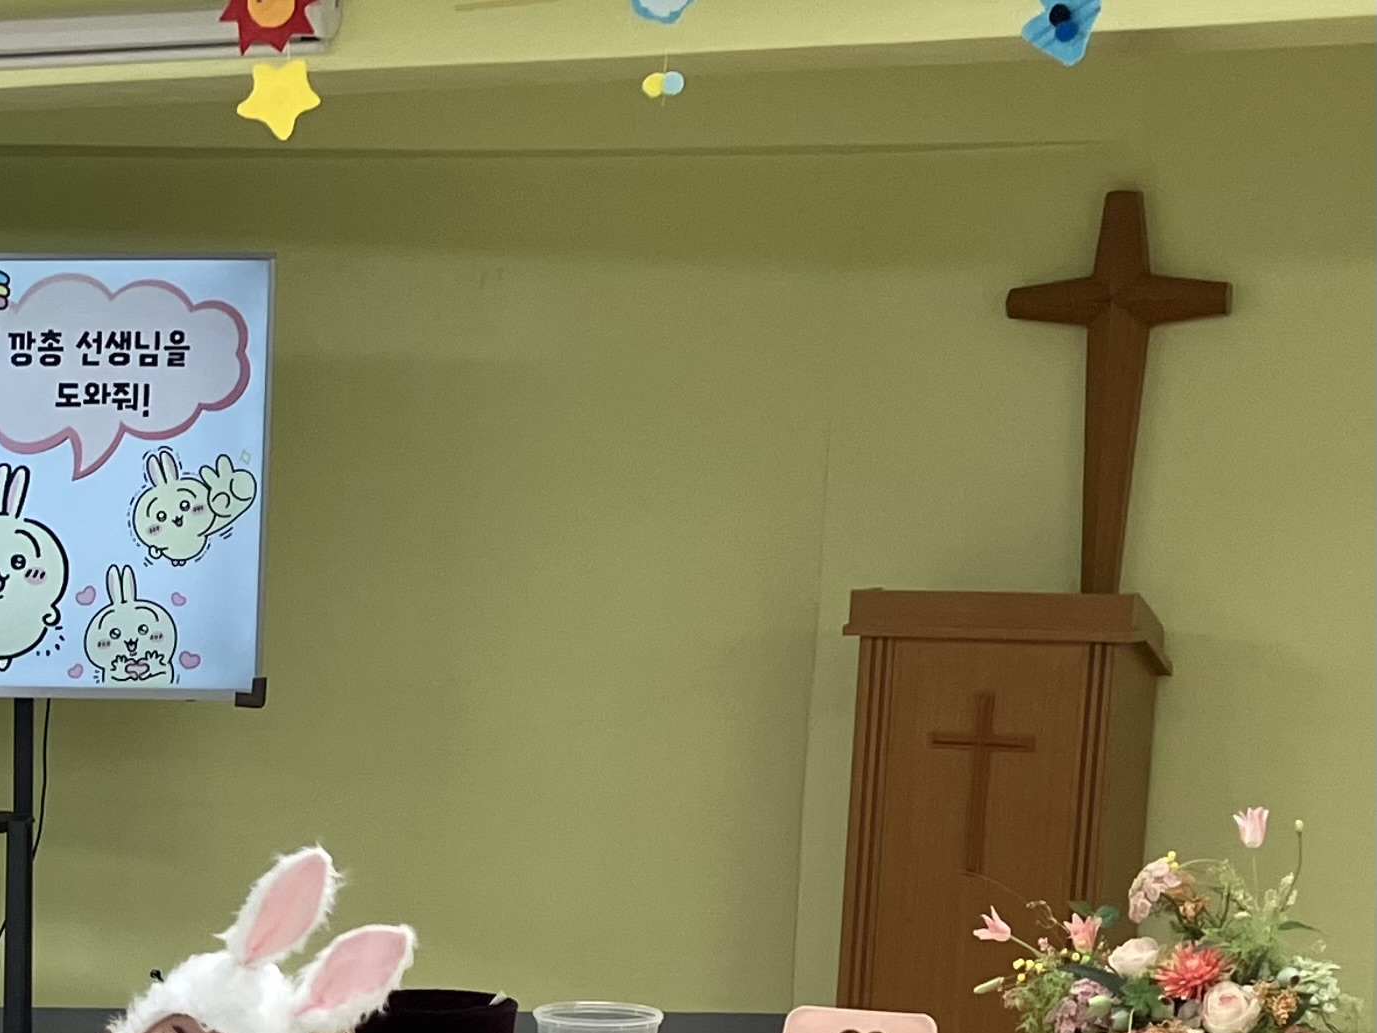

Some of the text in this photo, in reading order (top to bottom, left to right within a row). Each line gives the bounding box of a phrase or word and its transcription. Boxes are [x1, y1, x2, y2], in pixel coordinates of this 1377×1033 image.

[8, 329, 190, 367] 깡총 선생님을
[54, 382, 150, 417] 도와줘!
